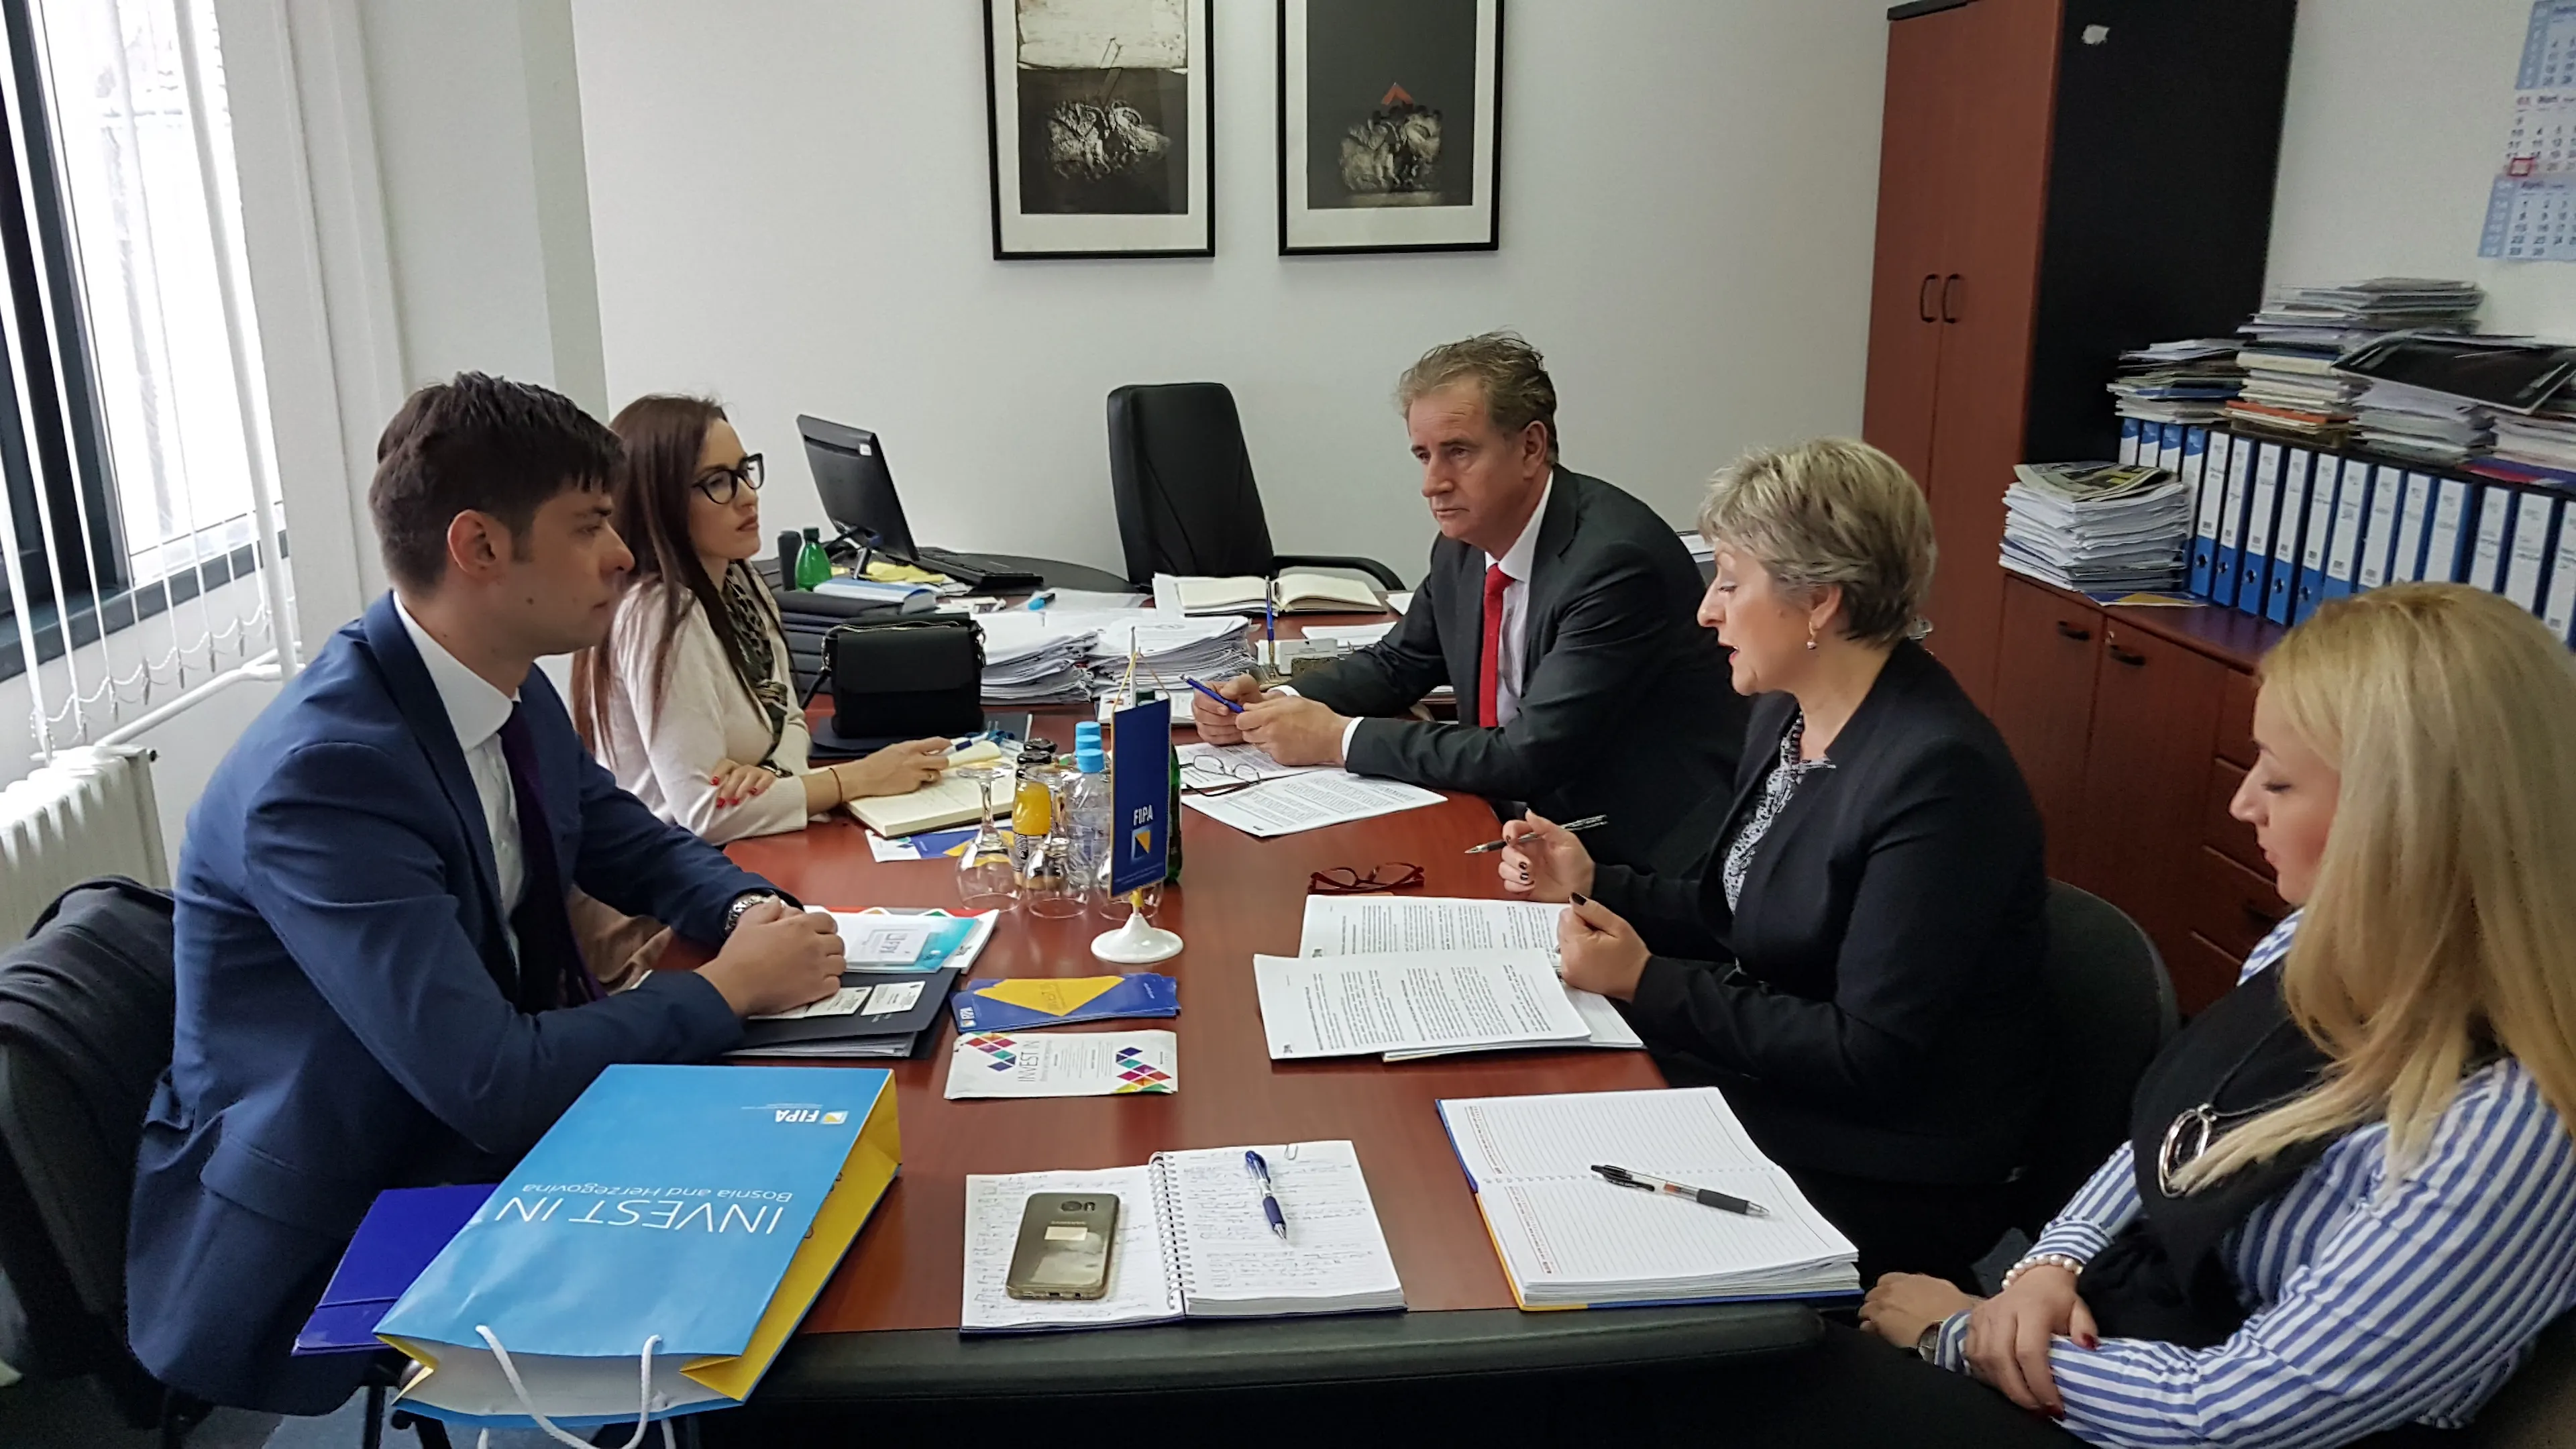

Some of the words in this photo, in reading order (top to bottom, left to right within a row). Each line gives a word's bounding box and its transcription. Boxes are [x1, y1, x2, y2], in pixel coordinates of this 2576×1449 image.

[1134, 805, 1153, 826] FIPA
[1018, 1051, 1039, 1082] INVEST
[775, 1110, 820, 1122] FIPA
[523, 1183, 661, 1196] Herzegovina
[665, 1186, 712, 1197] and
[717, 1187, 793, 1203] Bosnia
[494, 1196, 564, 1222] IN
[568, 1199, 784, 1234] INVEST
